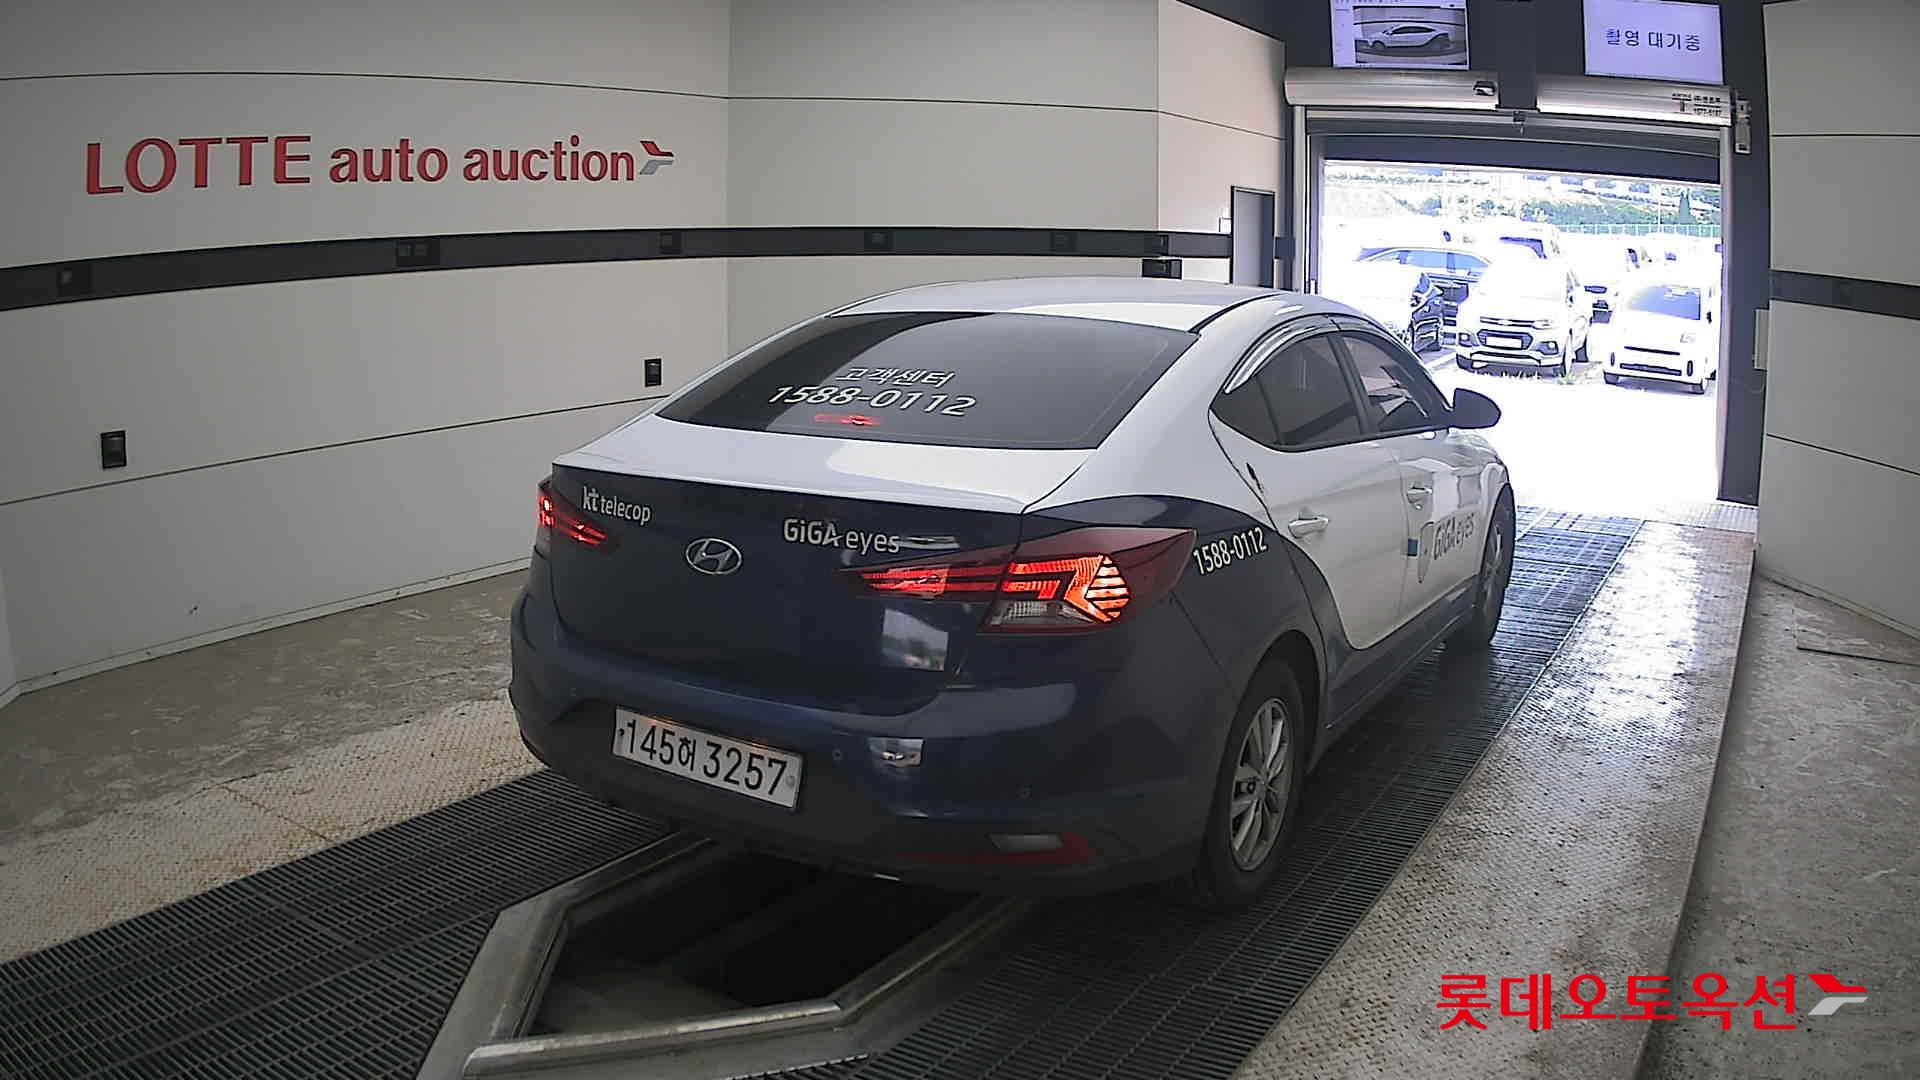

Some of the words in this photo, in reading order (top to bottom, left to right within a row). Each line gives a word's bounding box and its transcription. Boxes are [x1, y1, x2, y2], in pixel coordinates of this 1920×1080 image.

[1647, 31, 1701, 52] 대기중
[86, 135, 312, 196] LOTTE
[329, 138, 449, 184] auto
[463, 135, 636, 182] auction
[836, 368, 954, 388] 고객센터
[768, 385, 976, 416] 1588-0112
[583, 486, 599, 512] kt
[600, 495, 651, 526] telecop
[783, 518, 843, 547] GiGA
[845, 530, 900, 555] eyes
[1193, 526, 1268, 575] 1588-0112
[626, 719, 697, 772] 145허
[703, 740, 788, 796] 3257
